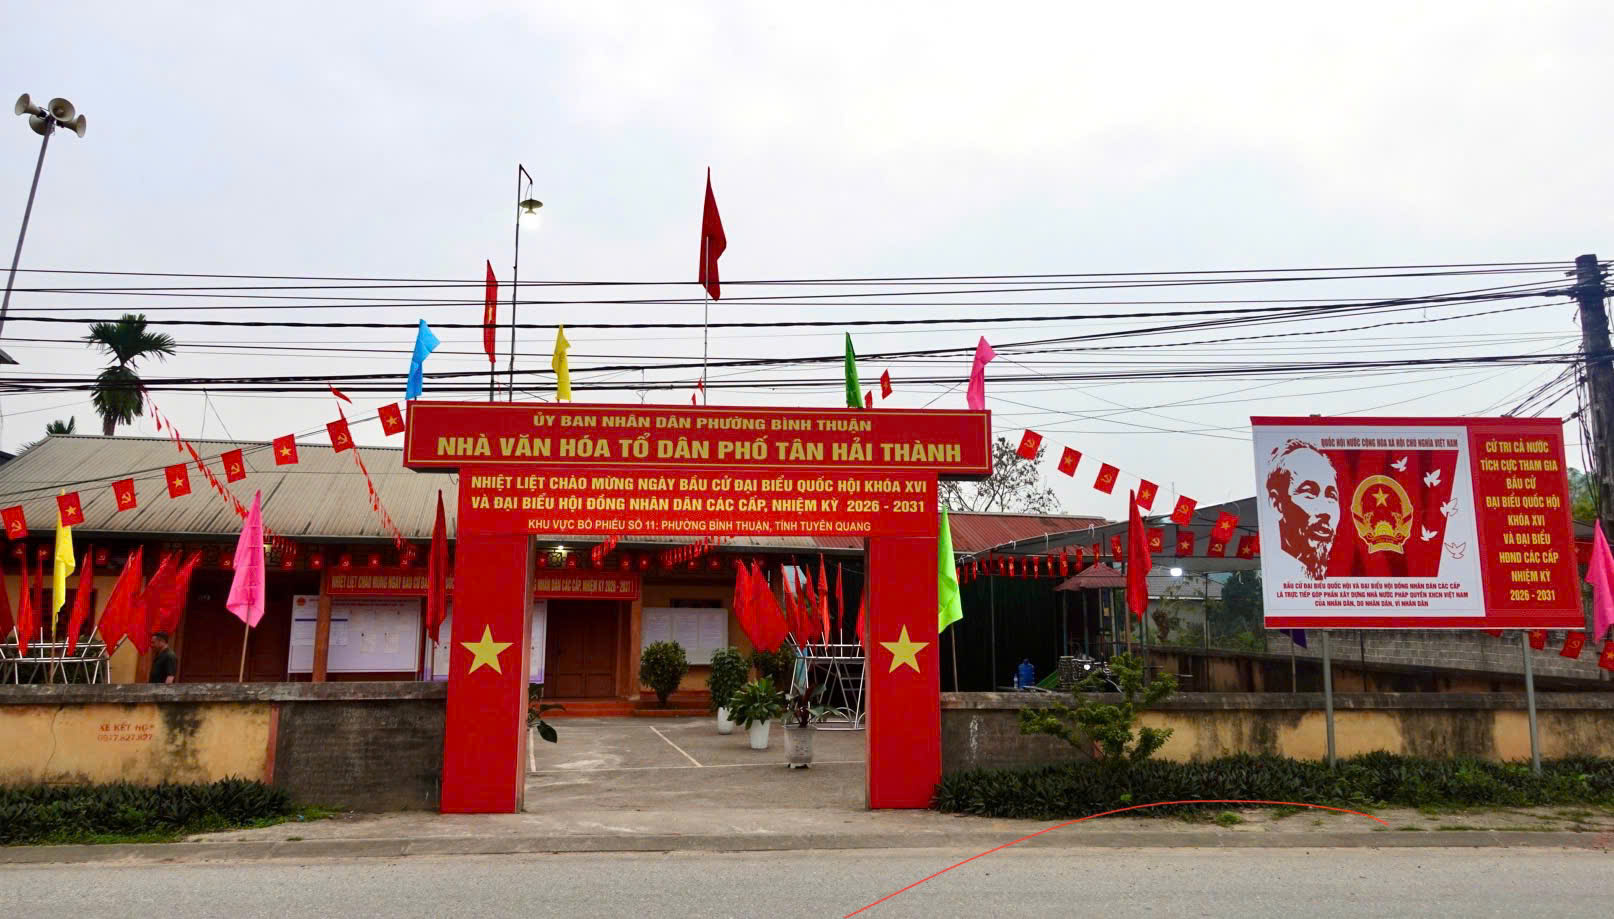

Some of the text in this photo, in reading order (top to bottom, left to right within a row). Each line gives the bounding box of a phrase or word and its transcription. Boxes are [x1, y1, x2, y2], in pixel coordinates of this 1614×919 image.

[534, 411, 872, 434] ỦY BAN NHÂN DÂN PHƯỜNG BÌNH THUẬN
[437, 432, 961, 462] NHÀ VĂN HÓA TỔ DÂN PHỐ TÂN HẢI THÀNH
[1486, 438, 1549, 453] CỬ TRI CẢ NƯỚC
[1480, 457, 1558, 473] TÍCH CỰC THAM GIA
[471, 474, 927, 495] NHIỆT LIỆT CHÀO MỪNG NGÀY BẦU CỬ ĐẠI BIỂU QUỐC HỘI KHÓA XVI
[1506, 474, 1537, 489] BẦU CỬ
[471, 495, 489, 509] VÀ
[494, 497, 518, 512] ĐẠI
[522, 493, 554, 510] BIỂU
[559, 495, 582, 512] HỘI
[586, 495, 625, 510] ĐỒNG
[629, 496, 669, 511] NHÂN
[673, 497, 702, 511] DÂN
[707, 497, 735, 511] CÁC
[739, 497, 767, 513] CẤP,
[772, 499, 817, 515] NHIỆM
[821, 498, 839, 512] KỲ
[847, 500, 879, 512] 2026
[893, 501, 924, 512] 2031
[1486, 491, 1560, 510] ĐẠI BIỂU QUỐC HỘI
[528, 519, 550, 529] KHU
[552, 519, 575, 531] VỰC
[577, 518, 592, 529] BỎ
[595, 518, 625, 530] PHIẾU
[628, 518, 642, 530] SỐ
[645, 520, 659, 529] 11:
[662, 519, 706, 531] PHƯỜNG
[709, 519, 732, 530] BÌNH
[736, 520, 772, 533] THUẬN,
[800, 520, 833, 531] TUYÊN
[835, 522, 871, 533] QUANG
[1507, 513, 1545, 527] KHÓA XVI
[1503, 529, 1551, 547] VÀ ĐẠI BIỂU
[1524, 550, 1541, 564] CÁC
[1542, 548, 1559, 564] CẤP
[1511, 568, 1551, 584] NHIỆM KỲ
[1510, 589, 1530, 601] 2026
[1537, 589, 1556, 601] 2031
